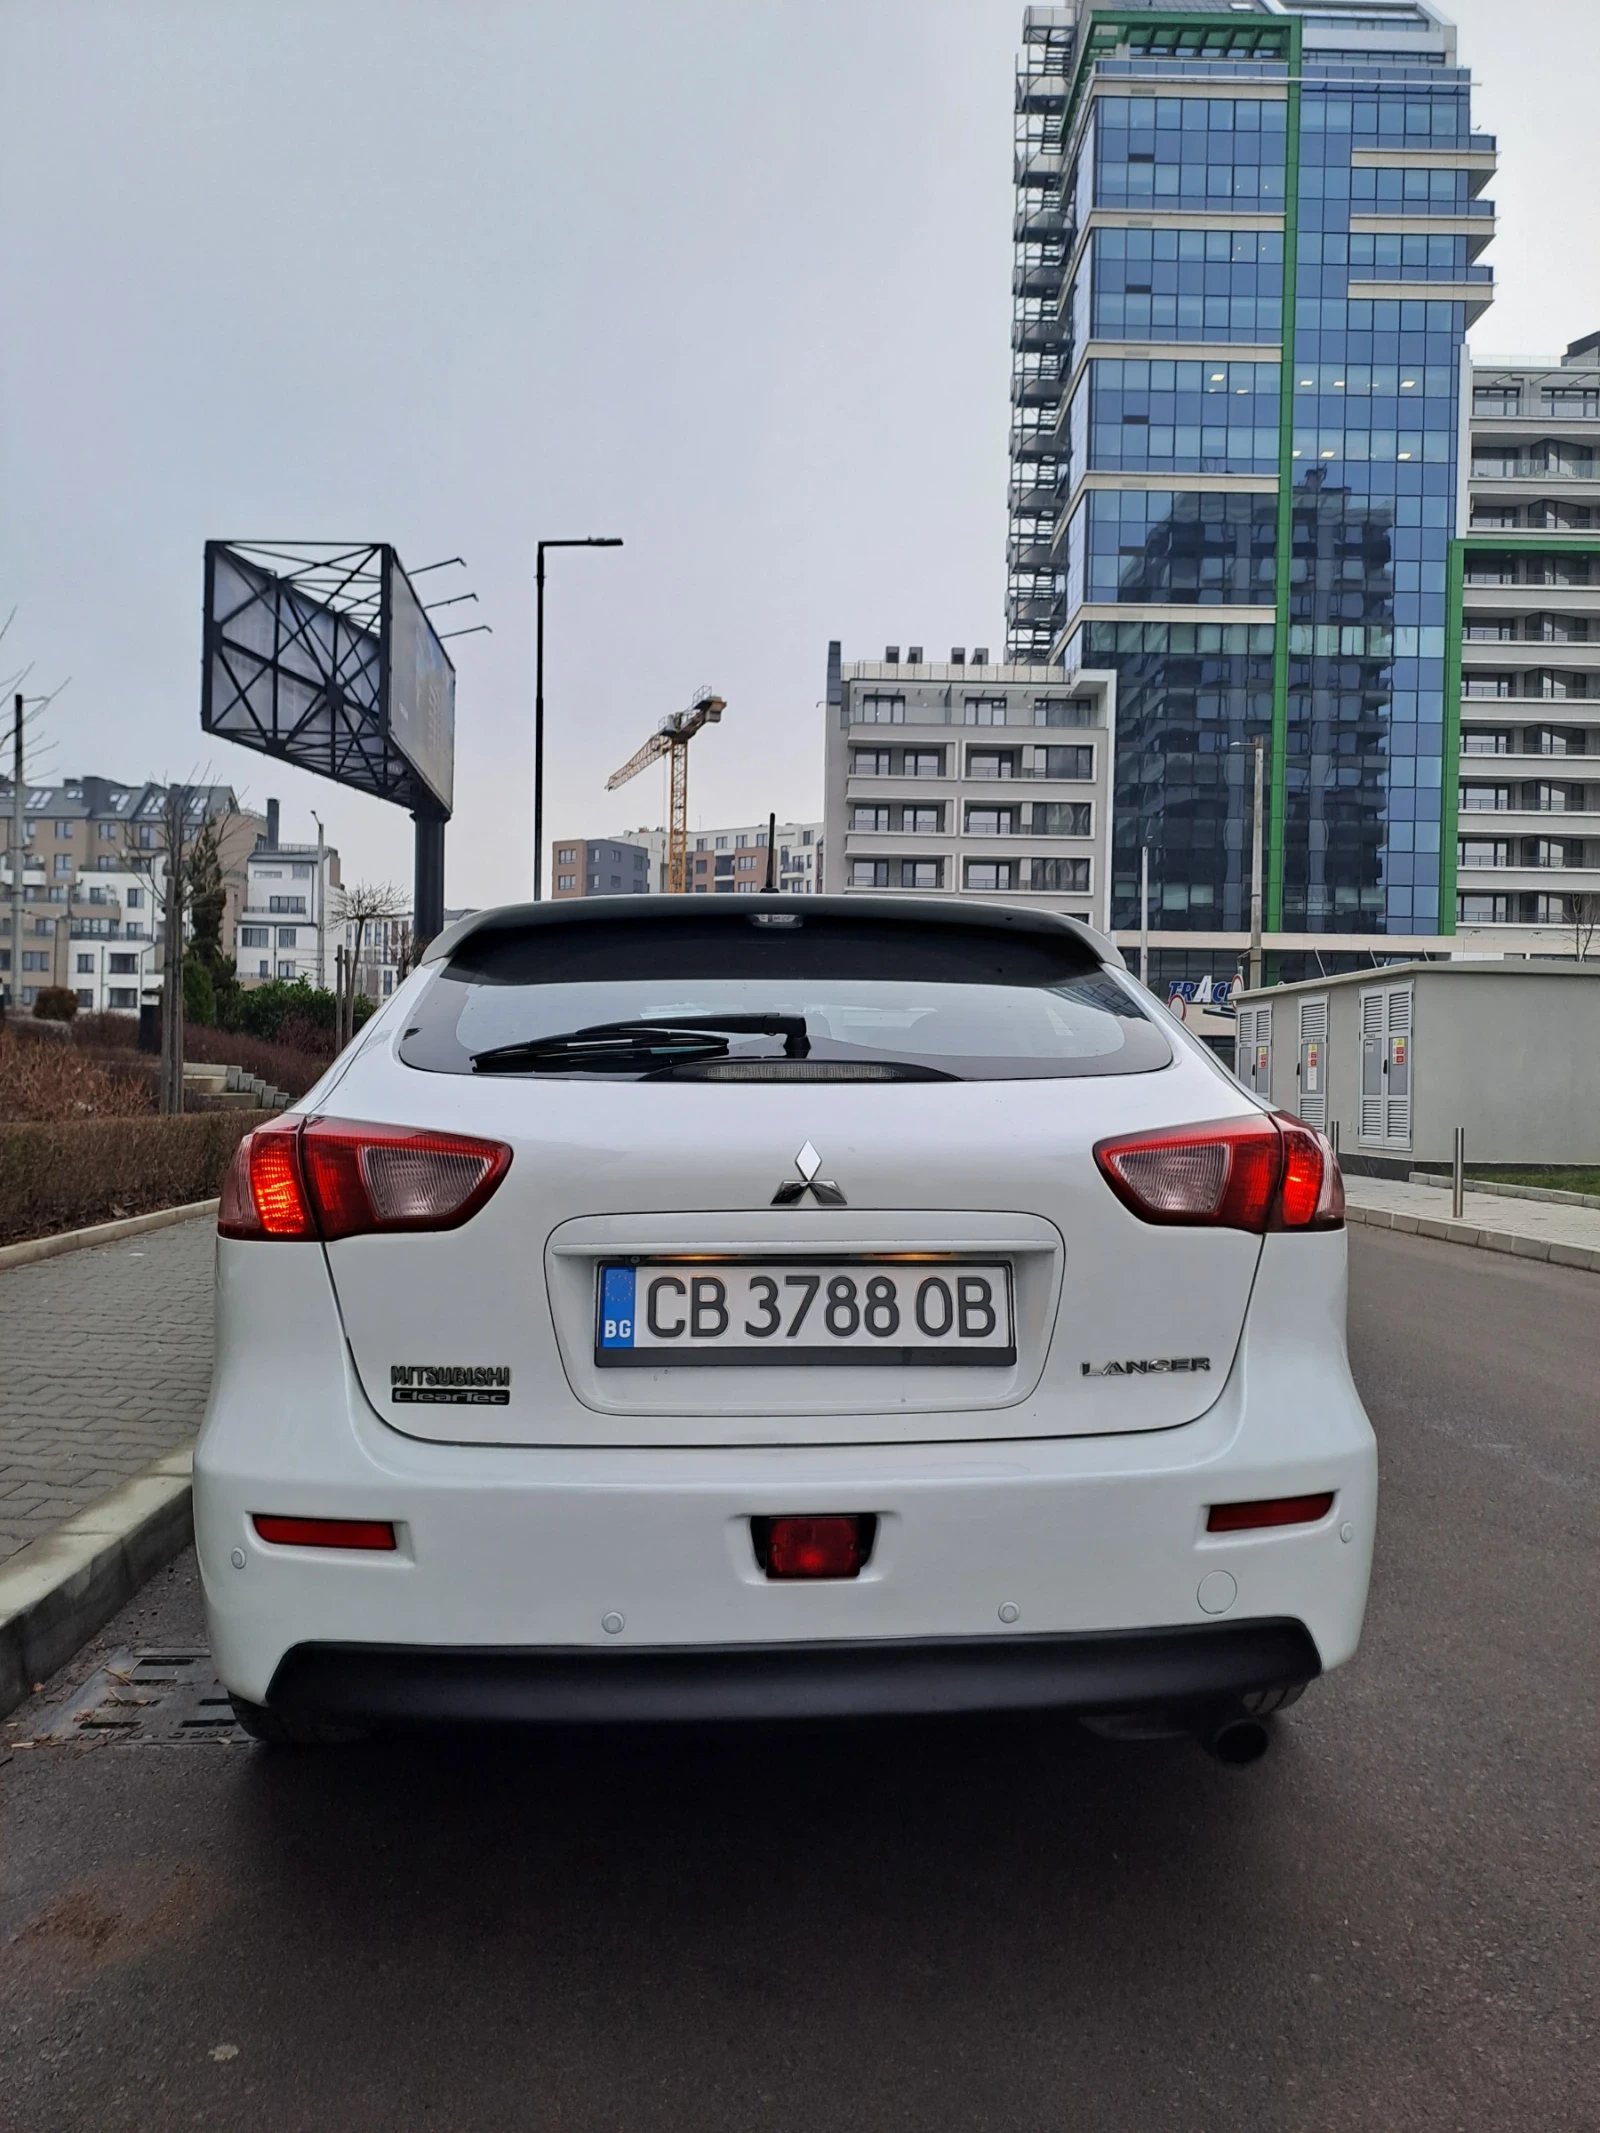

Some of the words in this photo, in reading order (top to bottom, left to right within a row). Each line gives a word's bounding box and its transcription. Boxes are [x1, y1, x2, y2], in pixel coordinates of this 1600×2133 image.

[647, 1276, 729, 1338] CB
[745, 1275, 900, 1338] 3788
[604, 1319, 631, 1338] BG
[391, 1365, 510, 1387] MITSUBISHI
[1081, 1357, 1211, 1376] LANCER
[394, 1390, 507, 1403] ClearTec
